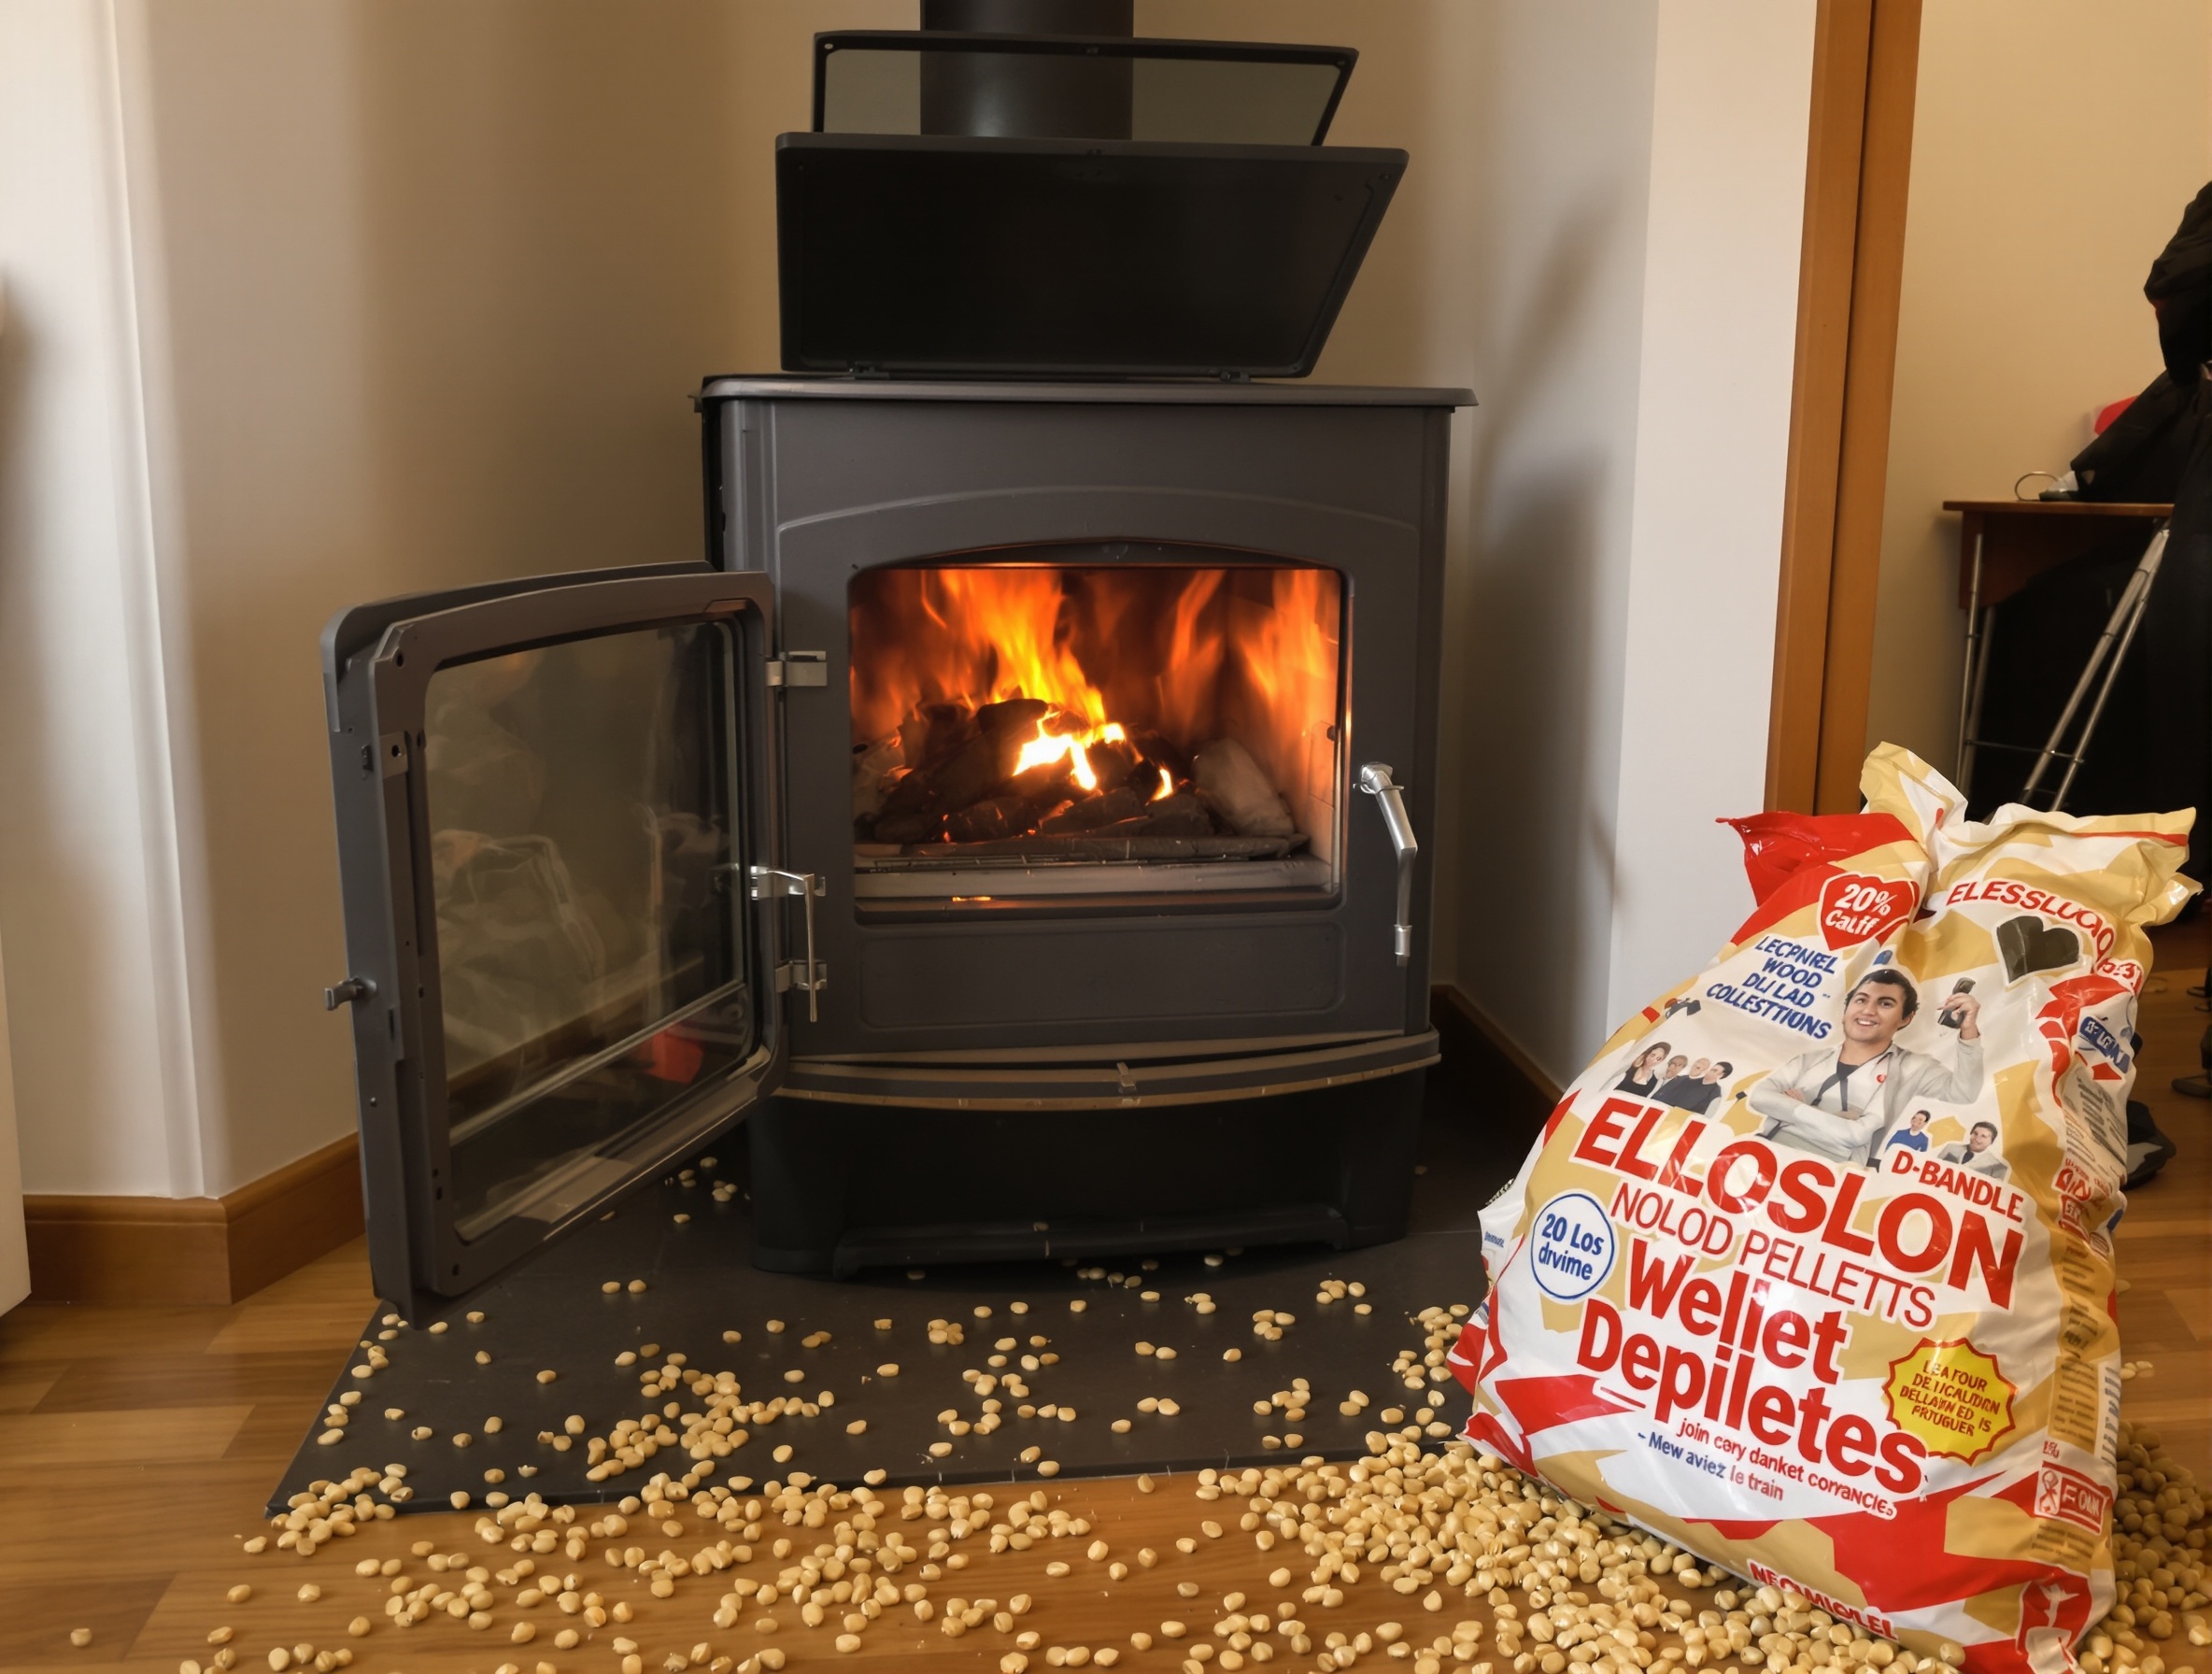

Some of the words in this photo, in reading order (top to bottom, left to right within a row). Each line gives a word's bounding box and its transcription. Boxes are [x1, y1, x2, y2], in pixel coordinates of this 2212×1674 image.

[1835, 883, 1897, 916] 20%
[1762, 958, 1822, 988] WOOD
[1772, 983, 1814, 1008] LAD
[1574, 1097, 2023, 1310] ELLOSLON
[1892, 1150, 2023, 1223] D-BANDLE
[1541, 1213, 1567, 1241] 20
[1570, 1224, 1604, 1256] Los
[1611, 1184, 1733, 1256] NOLOD
[1738, 1234, 1936, 1327] PELLETTS
[1577, 1298, 1927, 1494] Depiletes
[1978, 1417, 1992, 1432] IS
[1649, 1431, 1683, 1459] Mew
[1729, 1465, 1744, 1484] le
[1748, 1473, 1784, 1501] train
[1749, 1447, 1805, 1482] danket
